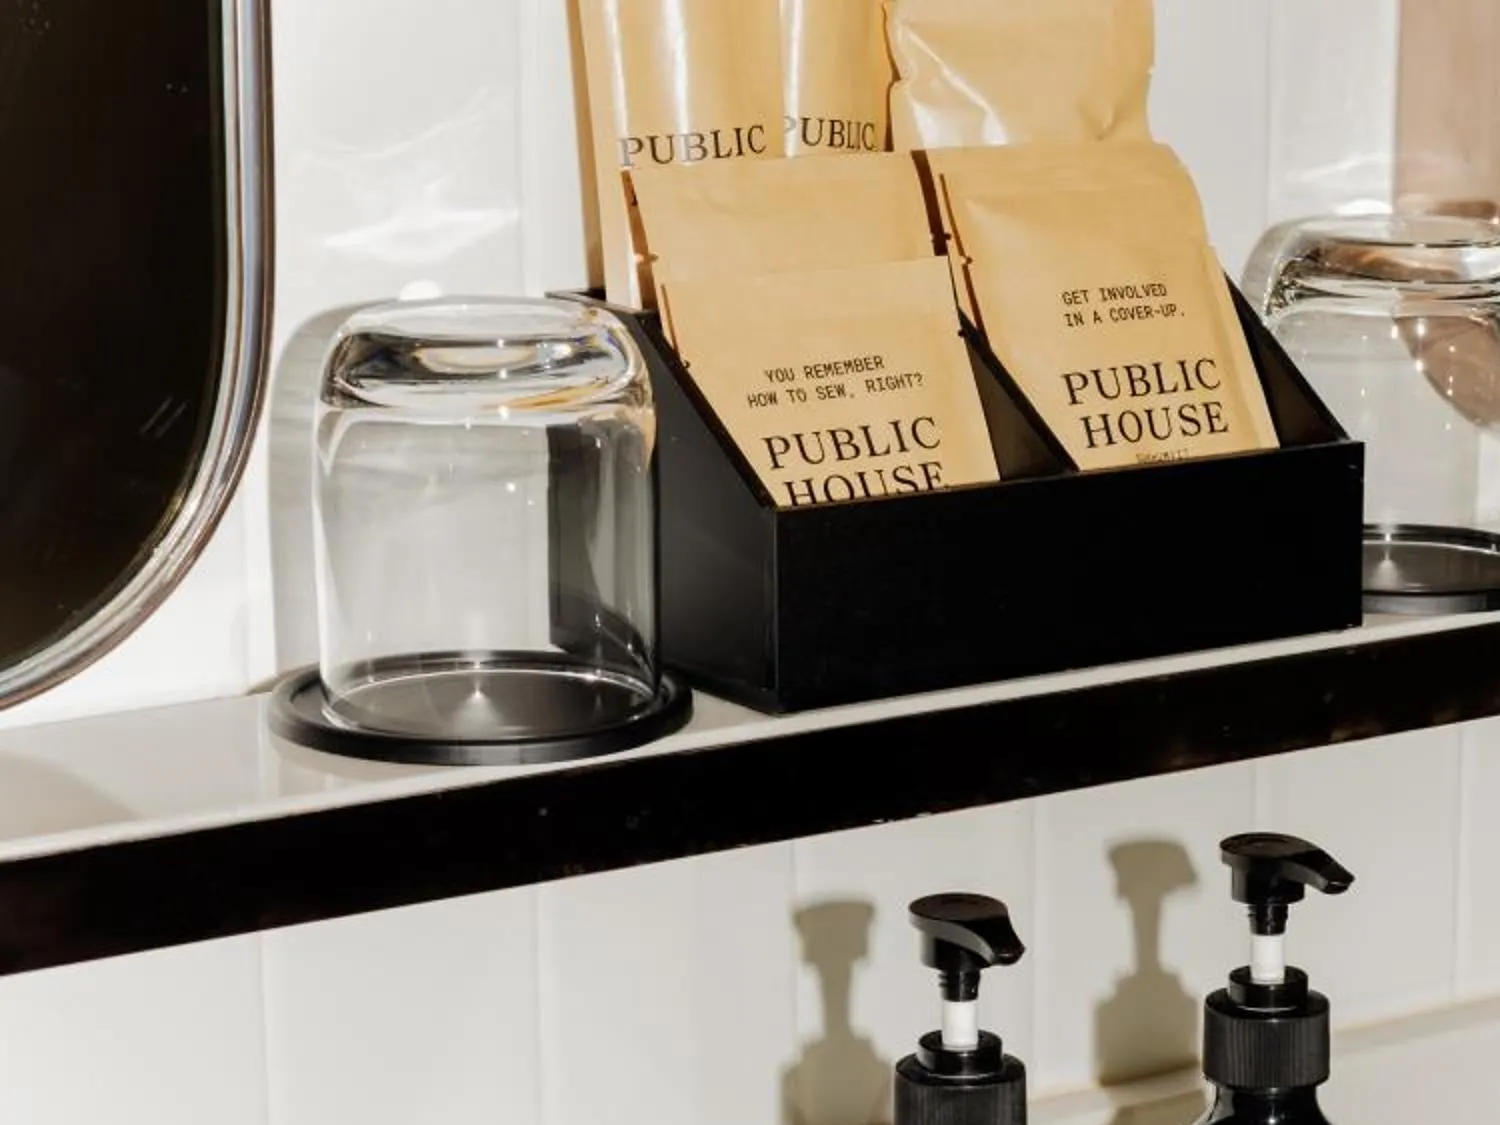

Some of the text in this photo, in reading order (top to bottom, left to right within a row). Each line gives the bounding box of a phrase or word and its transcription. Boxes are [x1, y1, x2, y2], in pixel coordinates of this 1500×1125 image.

[620, 125, 767, 167] PUBLIC
[1062, 283, 1167, 305] GET INVOLVED
[1064, 304, 1185, 327] IN A COVER-UP.
[765, 355, 885, 383] YOU REMEMBER
[1061, 358, 1221, 406] PUBLIC
[747, 392, 779, 409] HOW
[785, 388, 807, 405] TO
[865, 372, 923, 393] RIGHT?
[761, 416, 941, 470] PUBLIC
[1080, 401, 1229, 448] HOUSE
